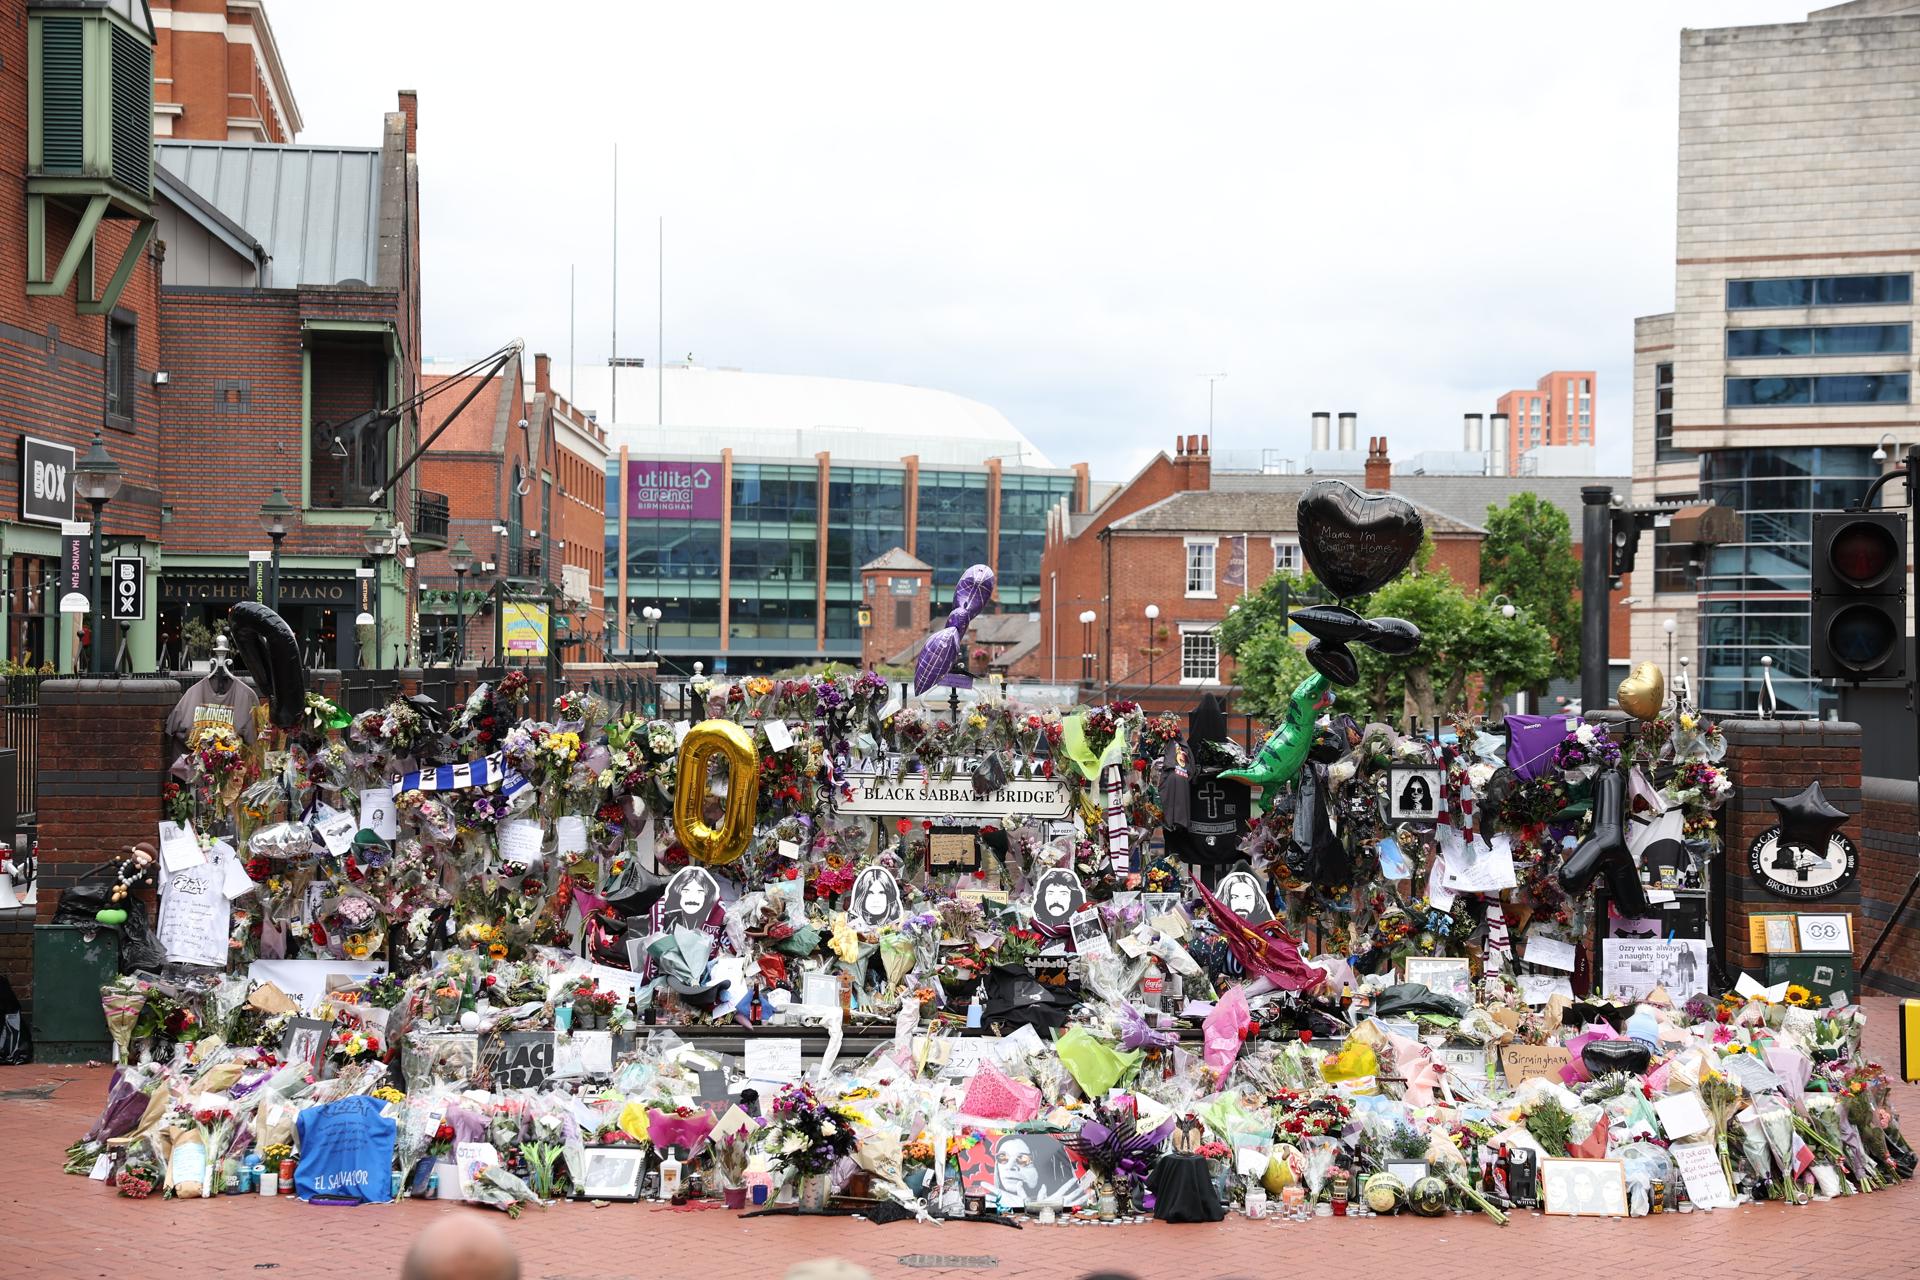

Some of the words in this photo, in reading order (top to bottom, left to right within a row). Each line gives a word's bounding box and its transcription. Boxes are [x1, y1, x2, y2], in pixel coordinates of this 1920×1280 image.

[34, 460, 66, 503] BOX
[638, 471, 691, 487] utilita
[638, 488, 693, 502] arena
[1321, 527, 1351, 539] Mama
[72, 540, 80, 570] HAVING
[72, 572, 80, 588] FUN
[119, 564, 136, 613] BOX
[280, 587, 343, 599] PIANO
[864, 788, 916, 800] BLACK
[994, 788, 1055, 803] BRIDGE
[1760, 828, 1781, 844] CAN
[1766, 879, 1798, 895] BROAD
[1801, 881, 1839, 896] STREET
[1656, 944, 1680, 952] always
[1024, 957, 1068, 968] Sabbath
[1624, 953, 1653, 961] naughty
[1656, 953, 1673, 961] boy!
[1508, 1051, 1568, 1068] Birmingham
[1521, 1065, 1548, 1076] Forever
[315, 1175, 326, 1189] EL
[328, 1169, 369, 1190] SALVADOR
